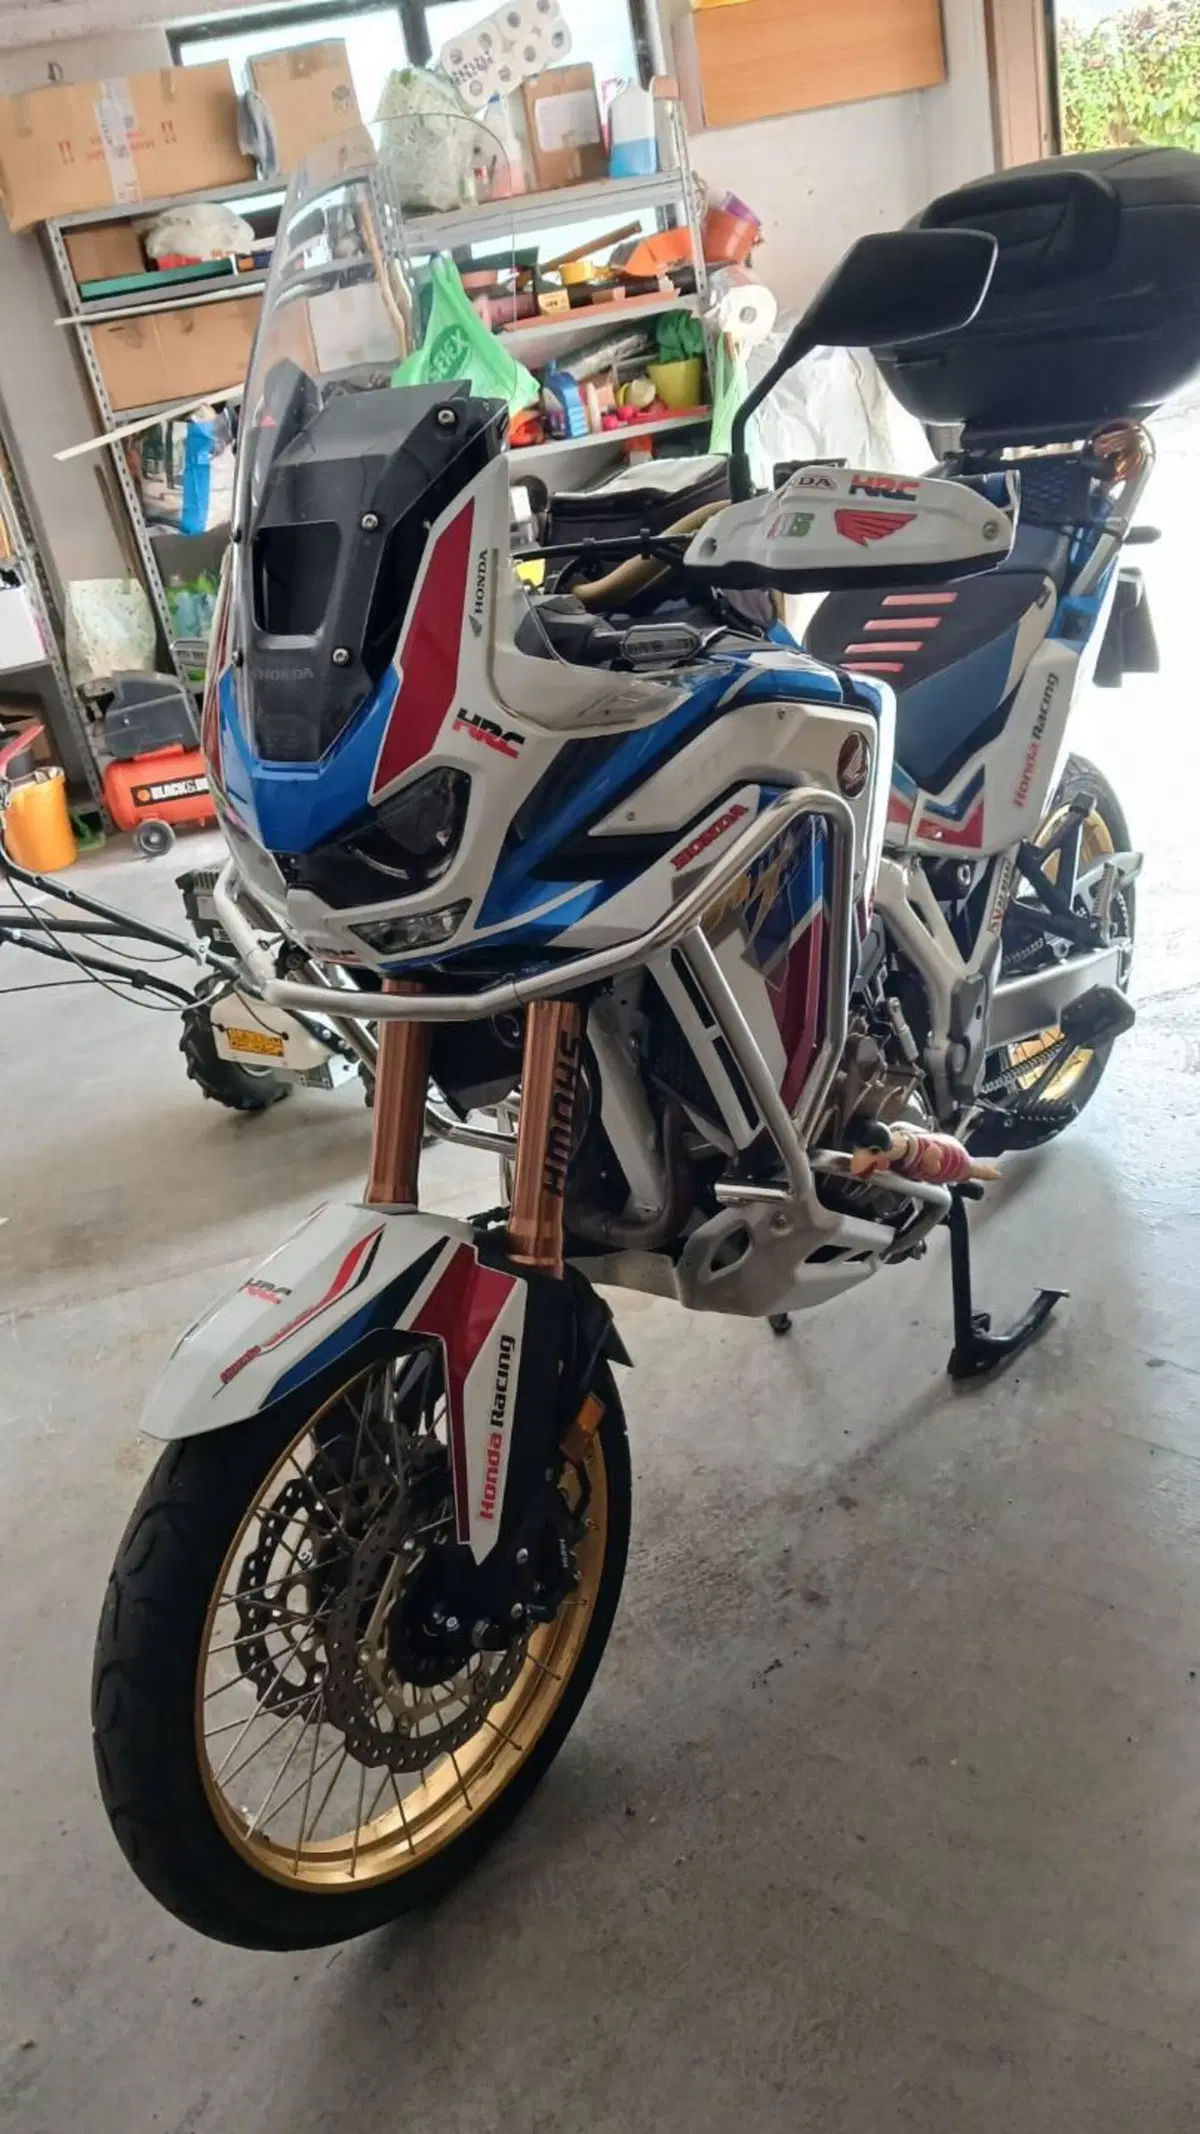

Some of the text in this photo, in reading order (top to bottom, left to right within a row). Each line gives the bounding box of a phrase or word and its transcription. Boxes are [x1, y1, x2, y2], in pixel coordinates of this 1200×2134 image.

[848, 474, 920, 502] HRC
[474, 548, 488, 614] HONDA
[451, 707, 526, 760] HRC
[1012, 671, 1060, 809] Honda Racing
[543, 1029, 582, 1196] SHOWA
[479, 1334, 517, 1521] Honda Racing
